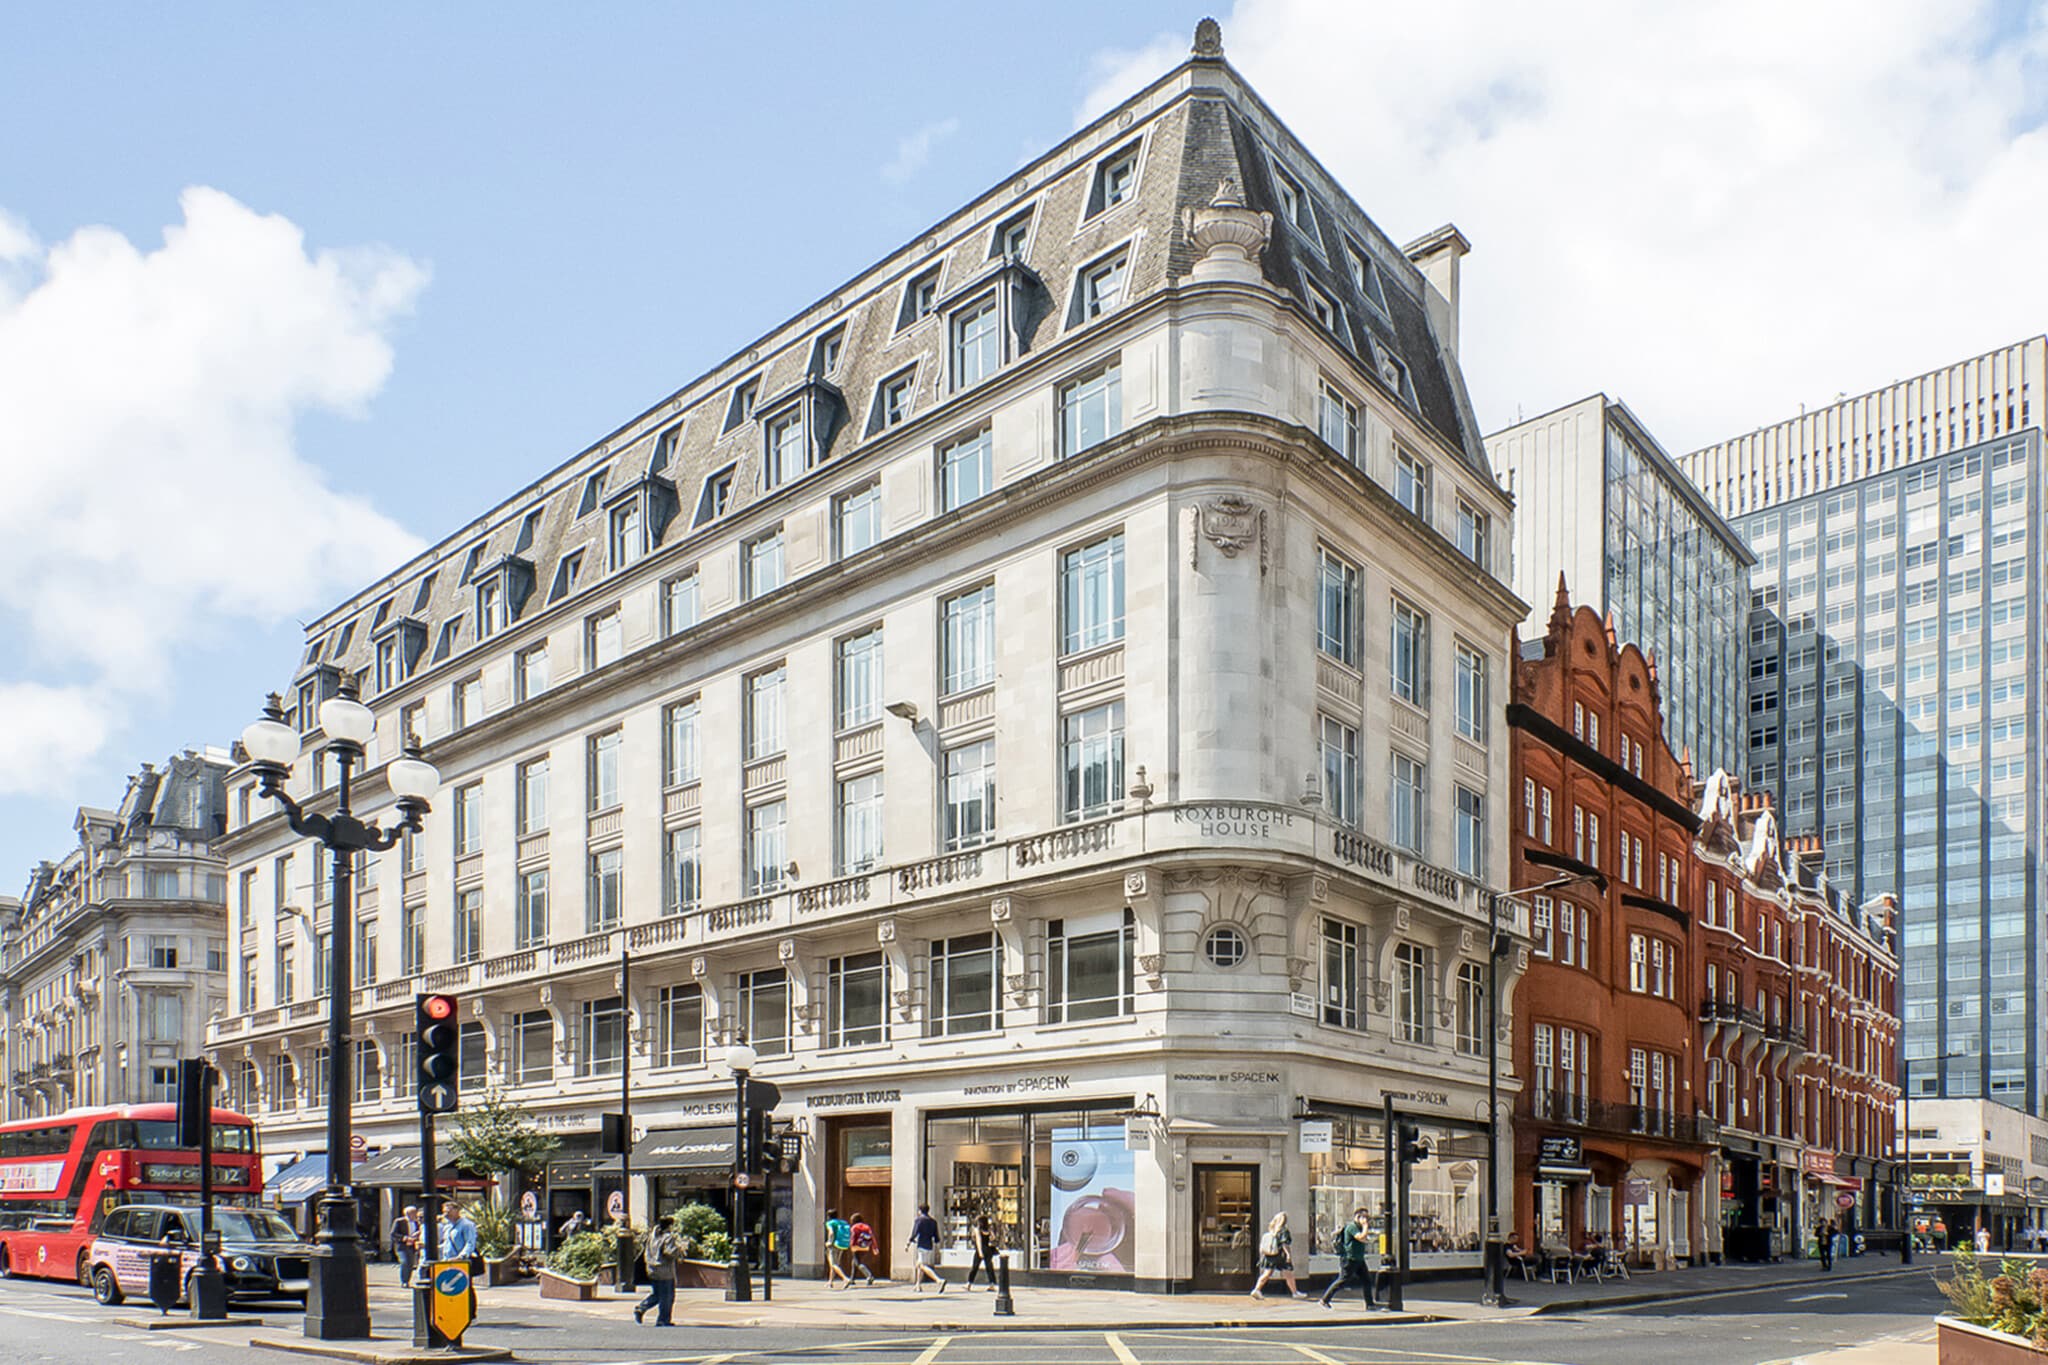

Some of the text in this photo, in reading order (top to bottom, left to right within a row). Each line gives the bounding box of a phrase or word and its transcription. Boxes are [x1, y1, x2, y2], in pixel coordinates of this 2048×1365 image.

[1174, 806, 1293, 827] ROXBURGHE
[1201, 822, 1269, 838] HOUSE
[866, 1089, 901, 1104] HOUSE
[682, 1102, 738, 1116] MOLESKI
